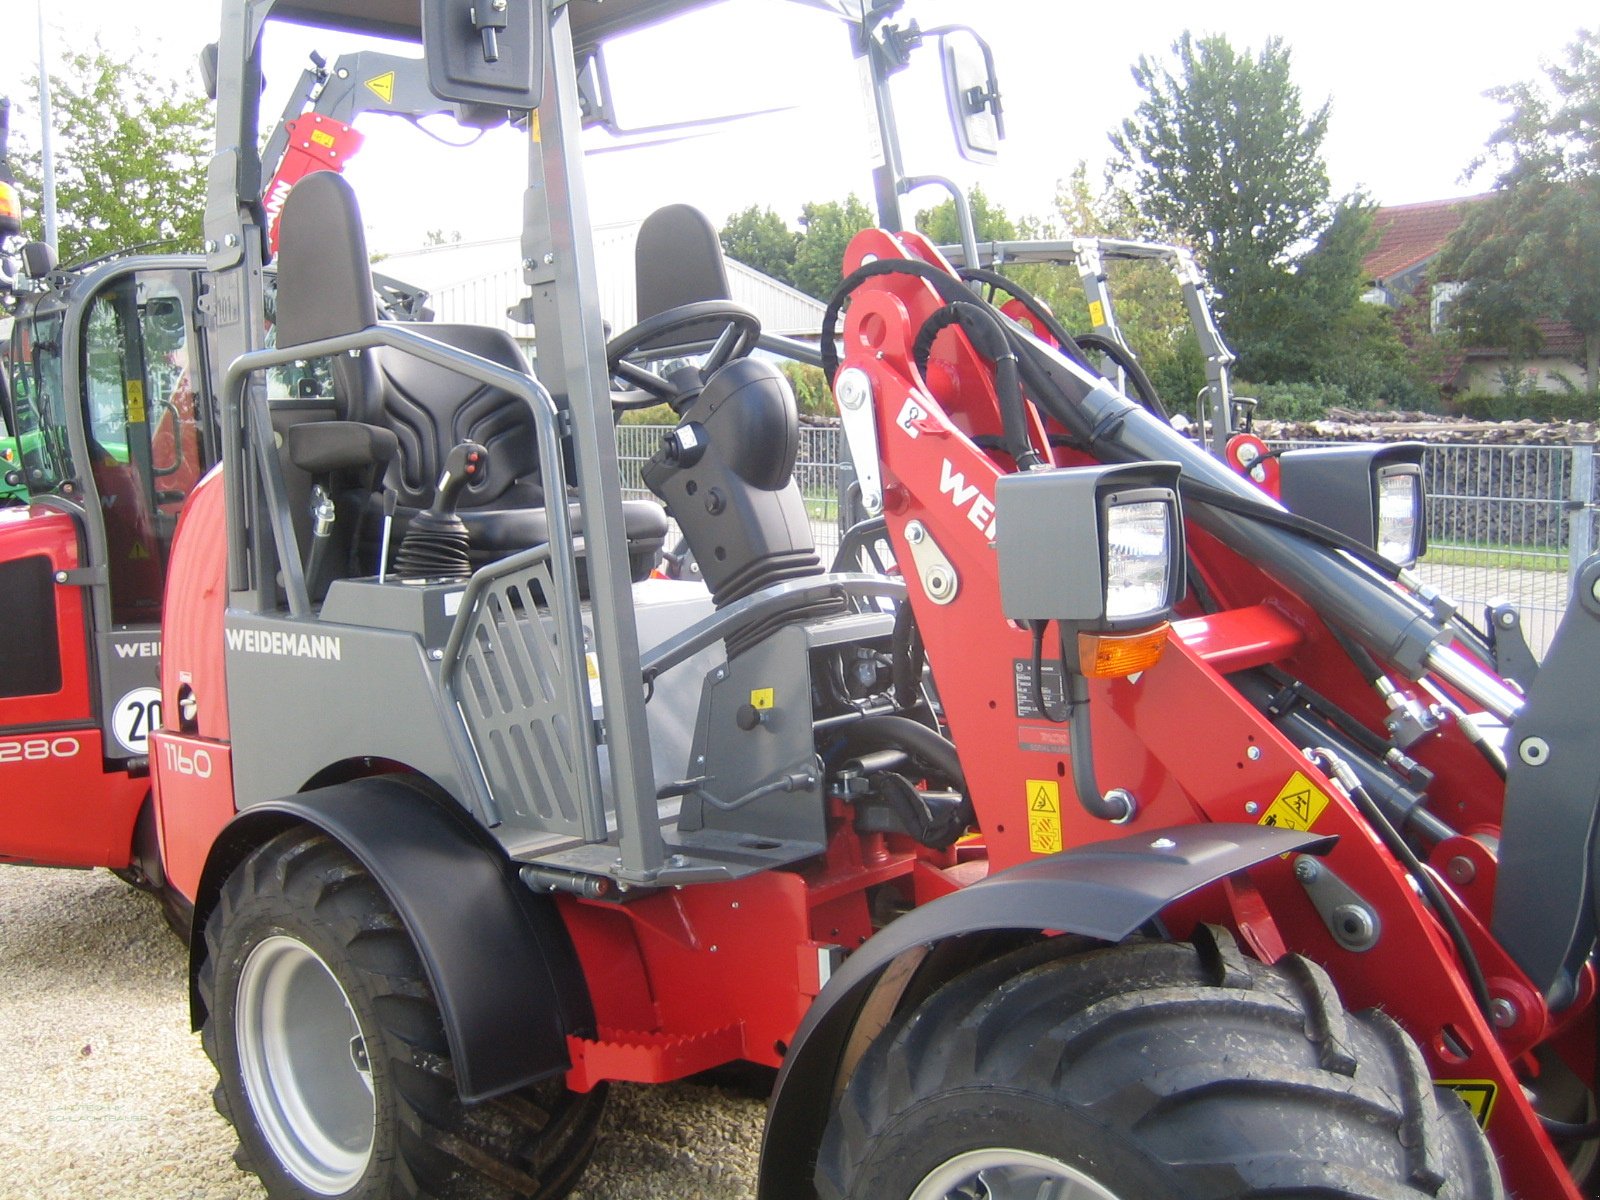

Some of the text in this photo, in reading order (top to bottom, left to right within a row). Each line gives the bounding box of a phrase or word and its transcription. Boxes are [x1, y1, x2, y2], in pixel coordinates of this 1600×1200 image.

[114, 641, 162, 658] WEI
[225, 628, 341, 661] WEIDEMANN
[126, 700, 162, 742] 20
[163, 742, 212, 779] 1160
